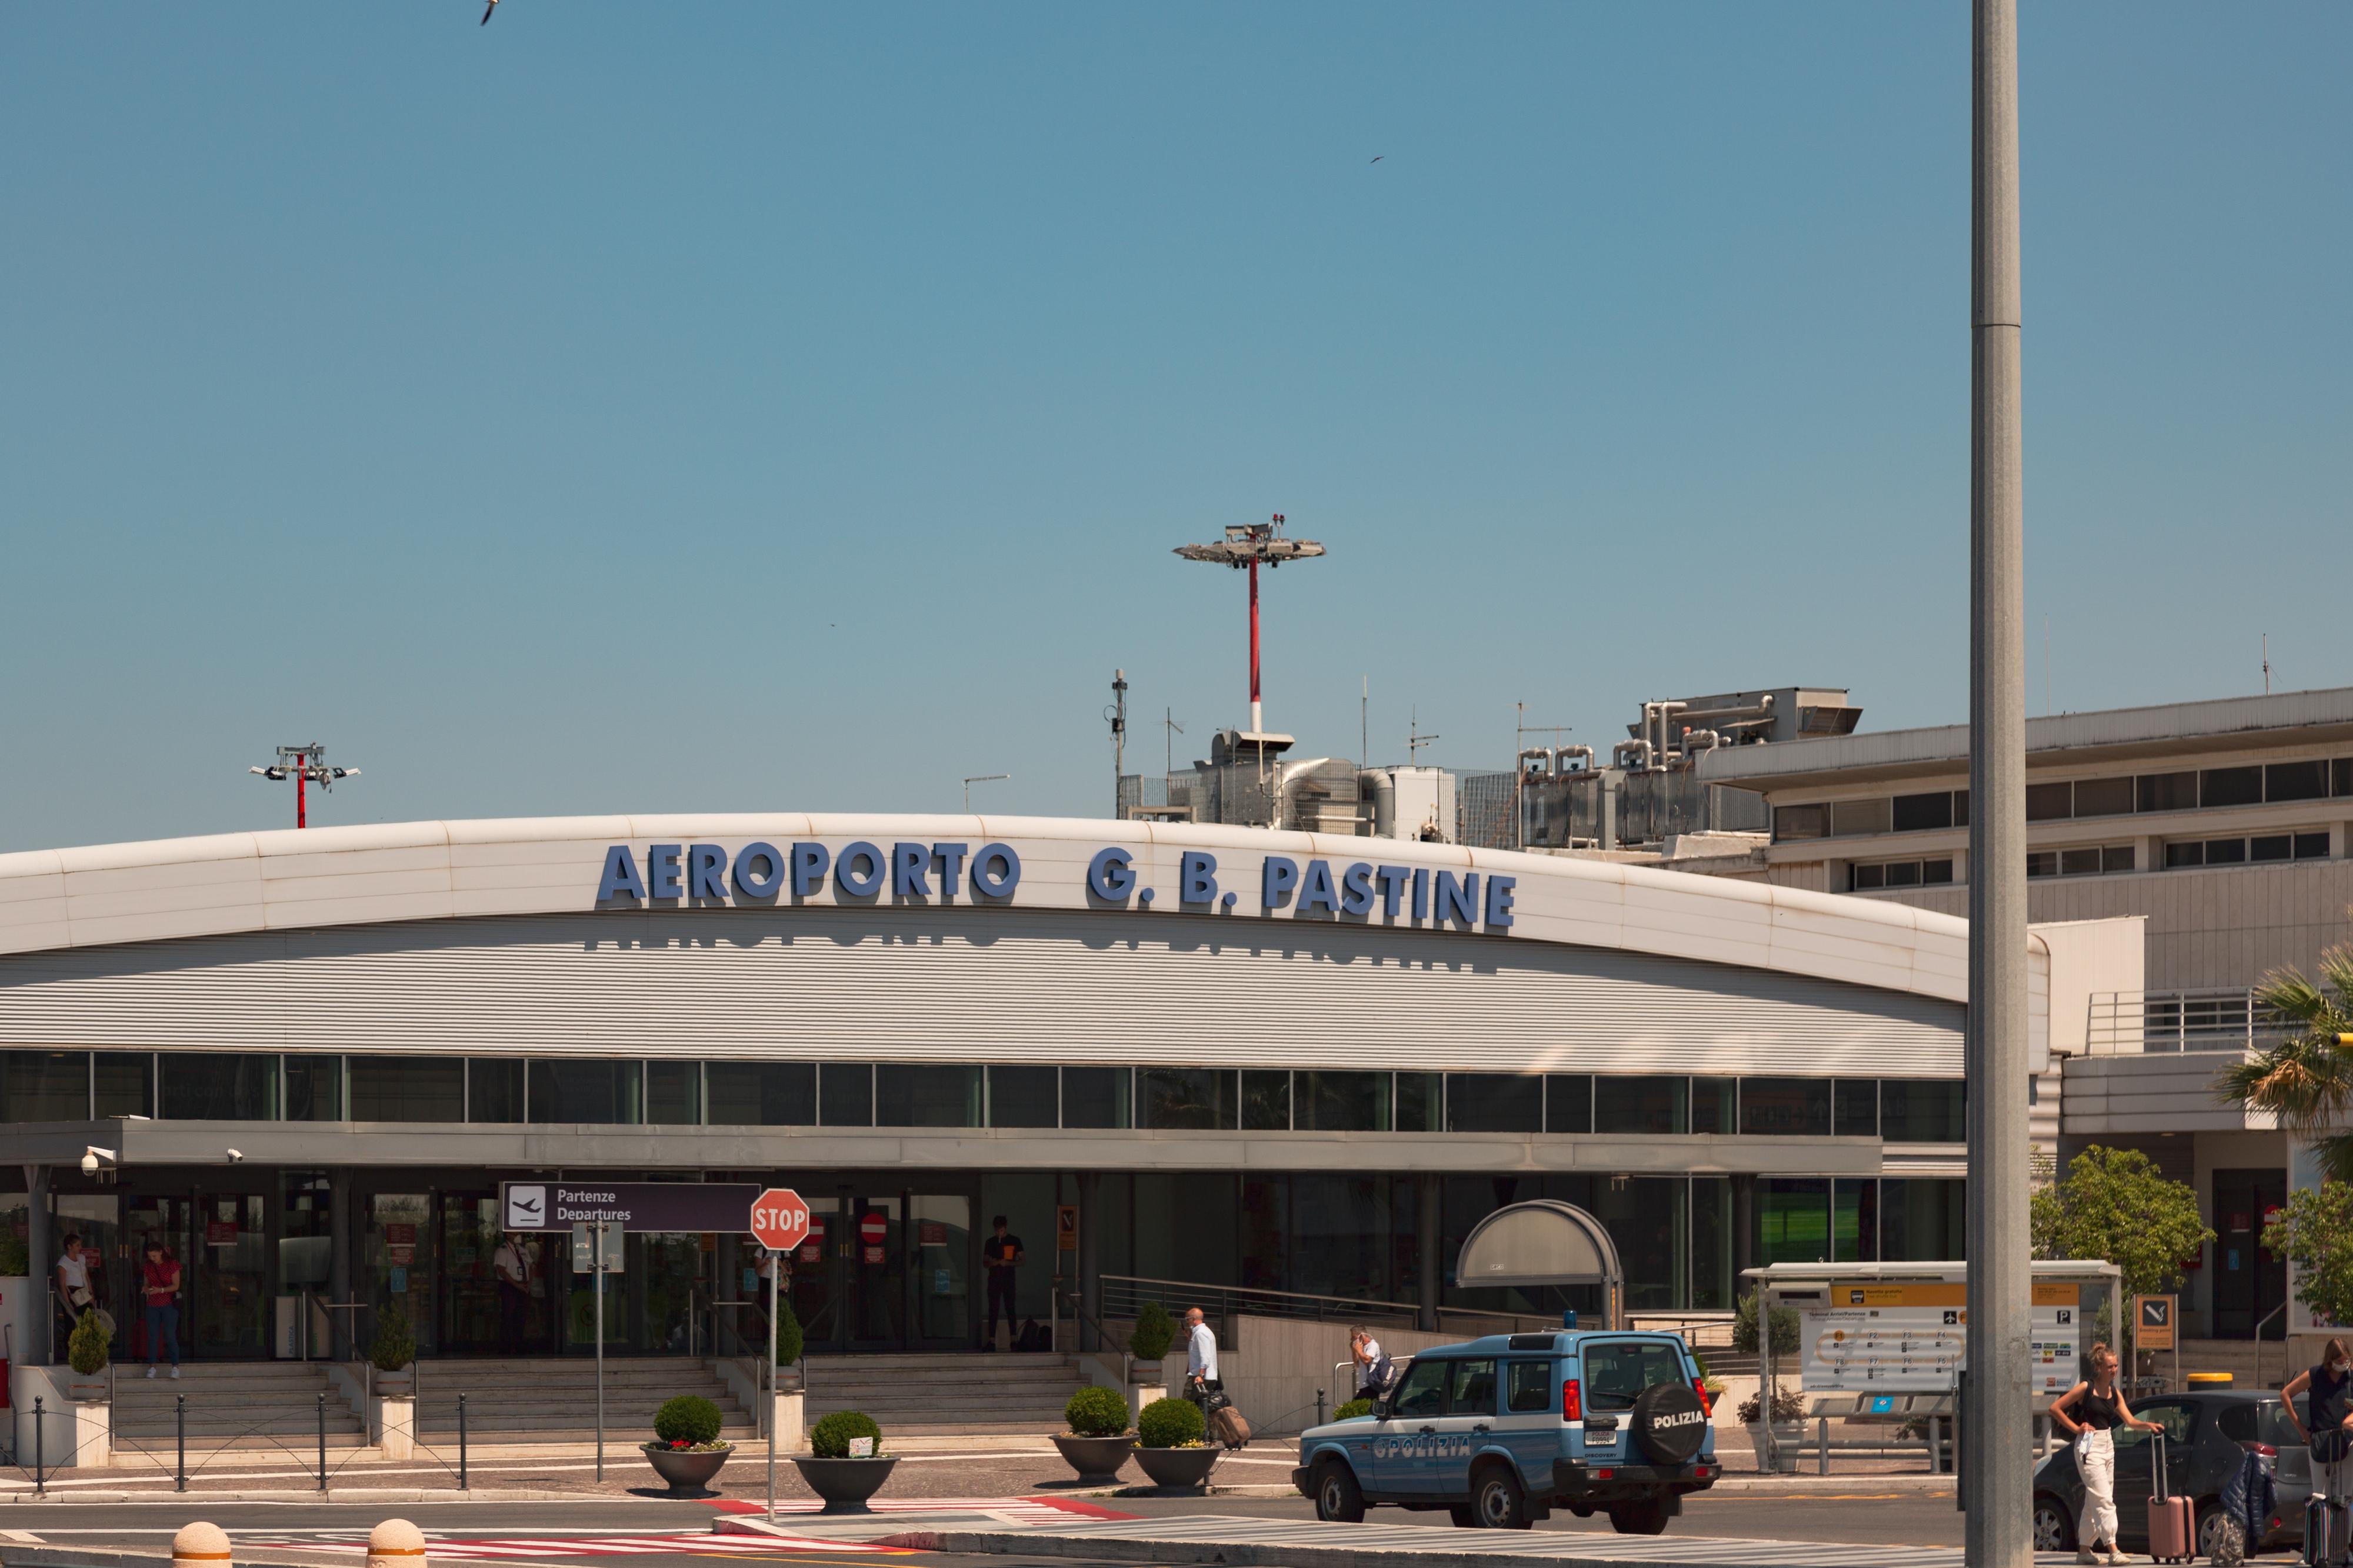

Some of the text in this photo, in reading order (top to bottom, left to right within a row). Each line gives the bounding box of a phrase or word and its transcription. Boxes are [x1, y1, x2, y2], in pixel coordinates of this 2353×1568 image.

[597, 841, 1517, 926] AEROPORTO G. B. PASTINE
[558, 1189, 616, 1202] Partenze
[558, 1207, 631, 1220] Departures
[755, 1208, 805, 1231] STOP
[1654, 1410, 1704, 1429] POLIZIA
[1388, 1436, 1471, 1458] POLIZIA
